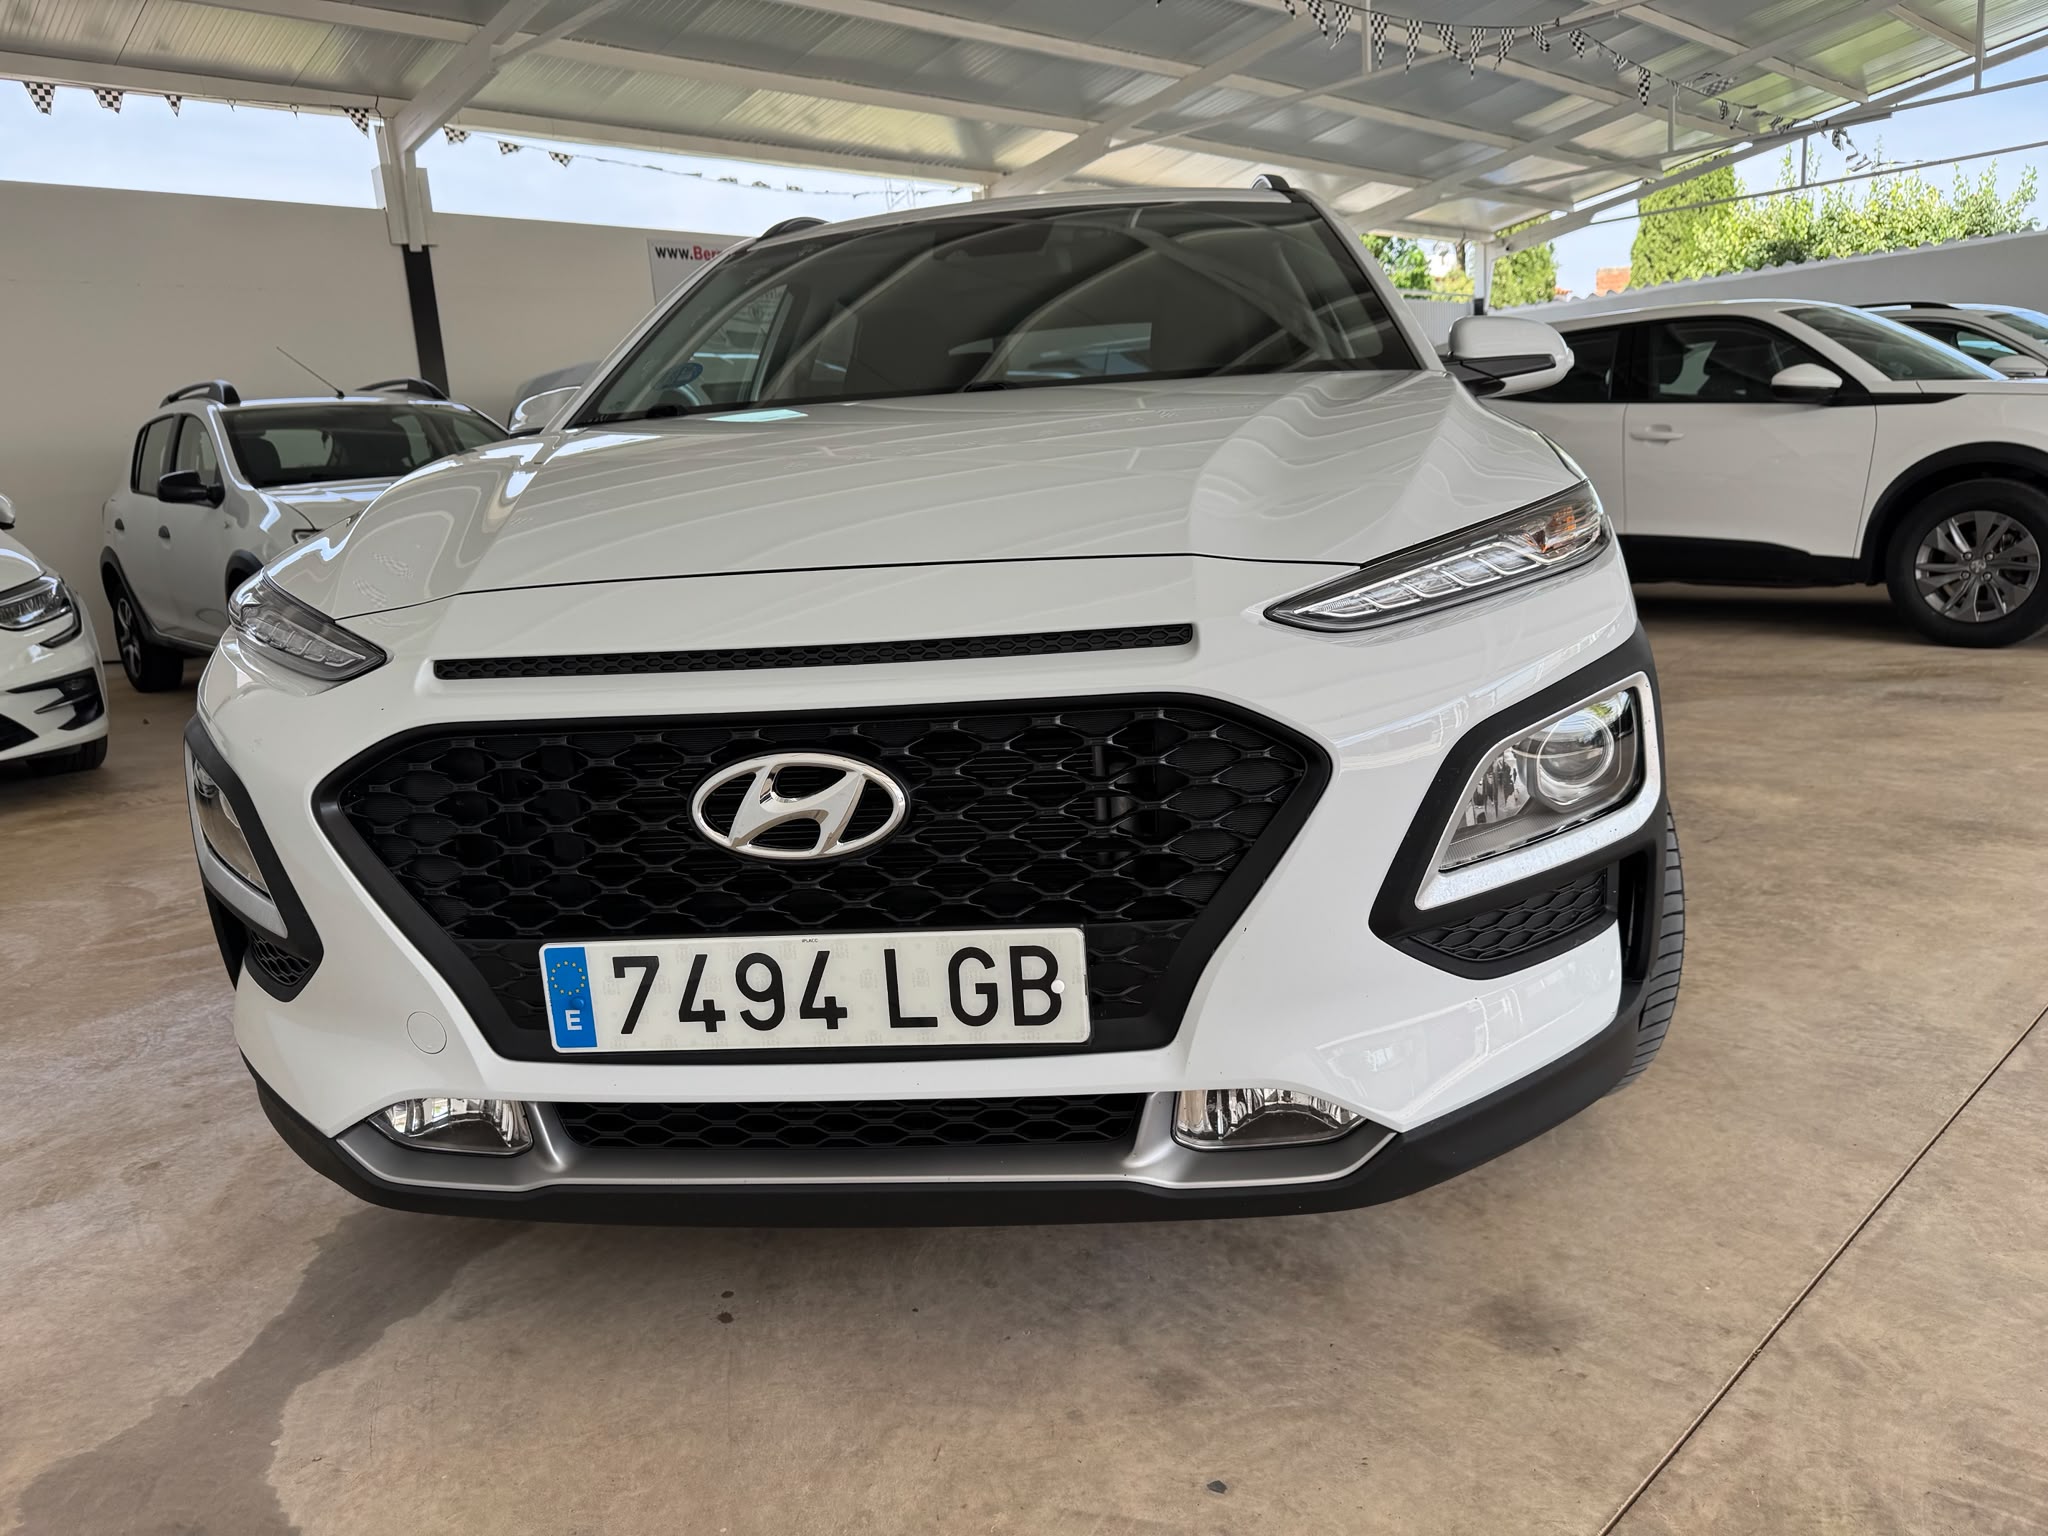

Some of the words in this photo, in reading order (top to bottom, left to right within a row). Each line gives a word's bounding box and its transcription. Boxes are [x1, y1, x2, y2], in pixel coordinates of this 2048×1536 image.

[612, 950, 848, 1035] 7494
[884, 945, 1062, 1029] LGB
[565, 1009, 582, 1031] E
